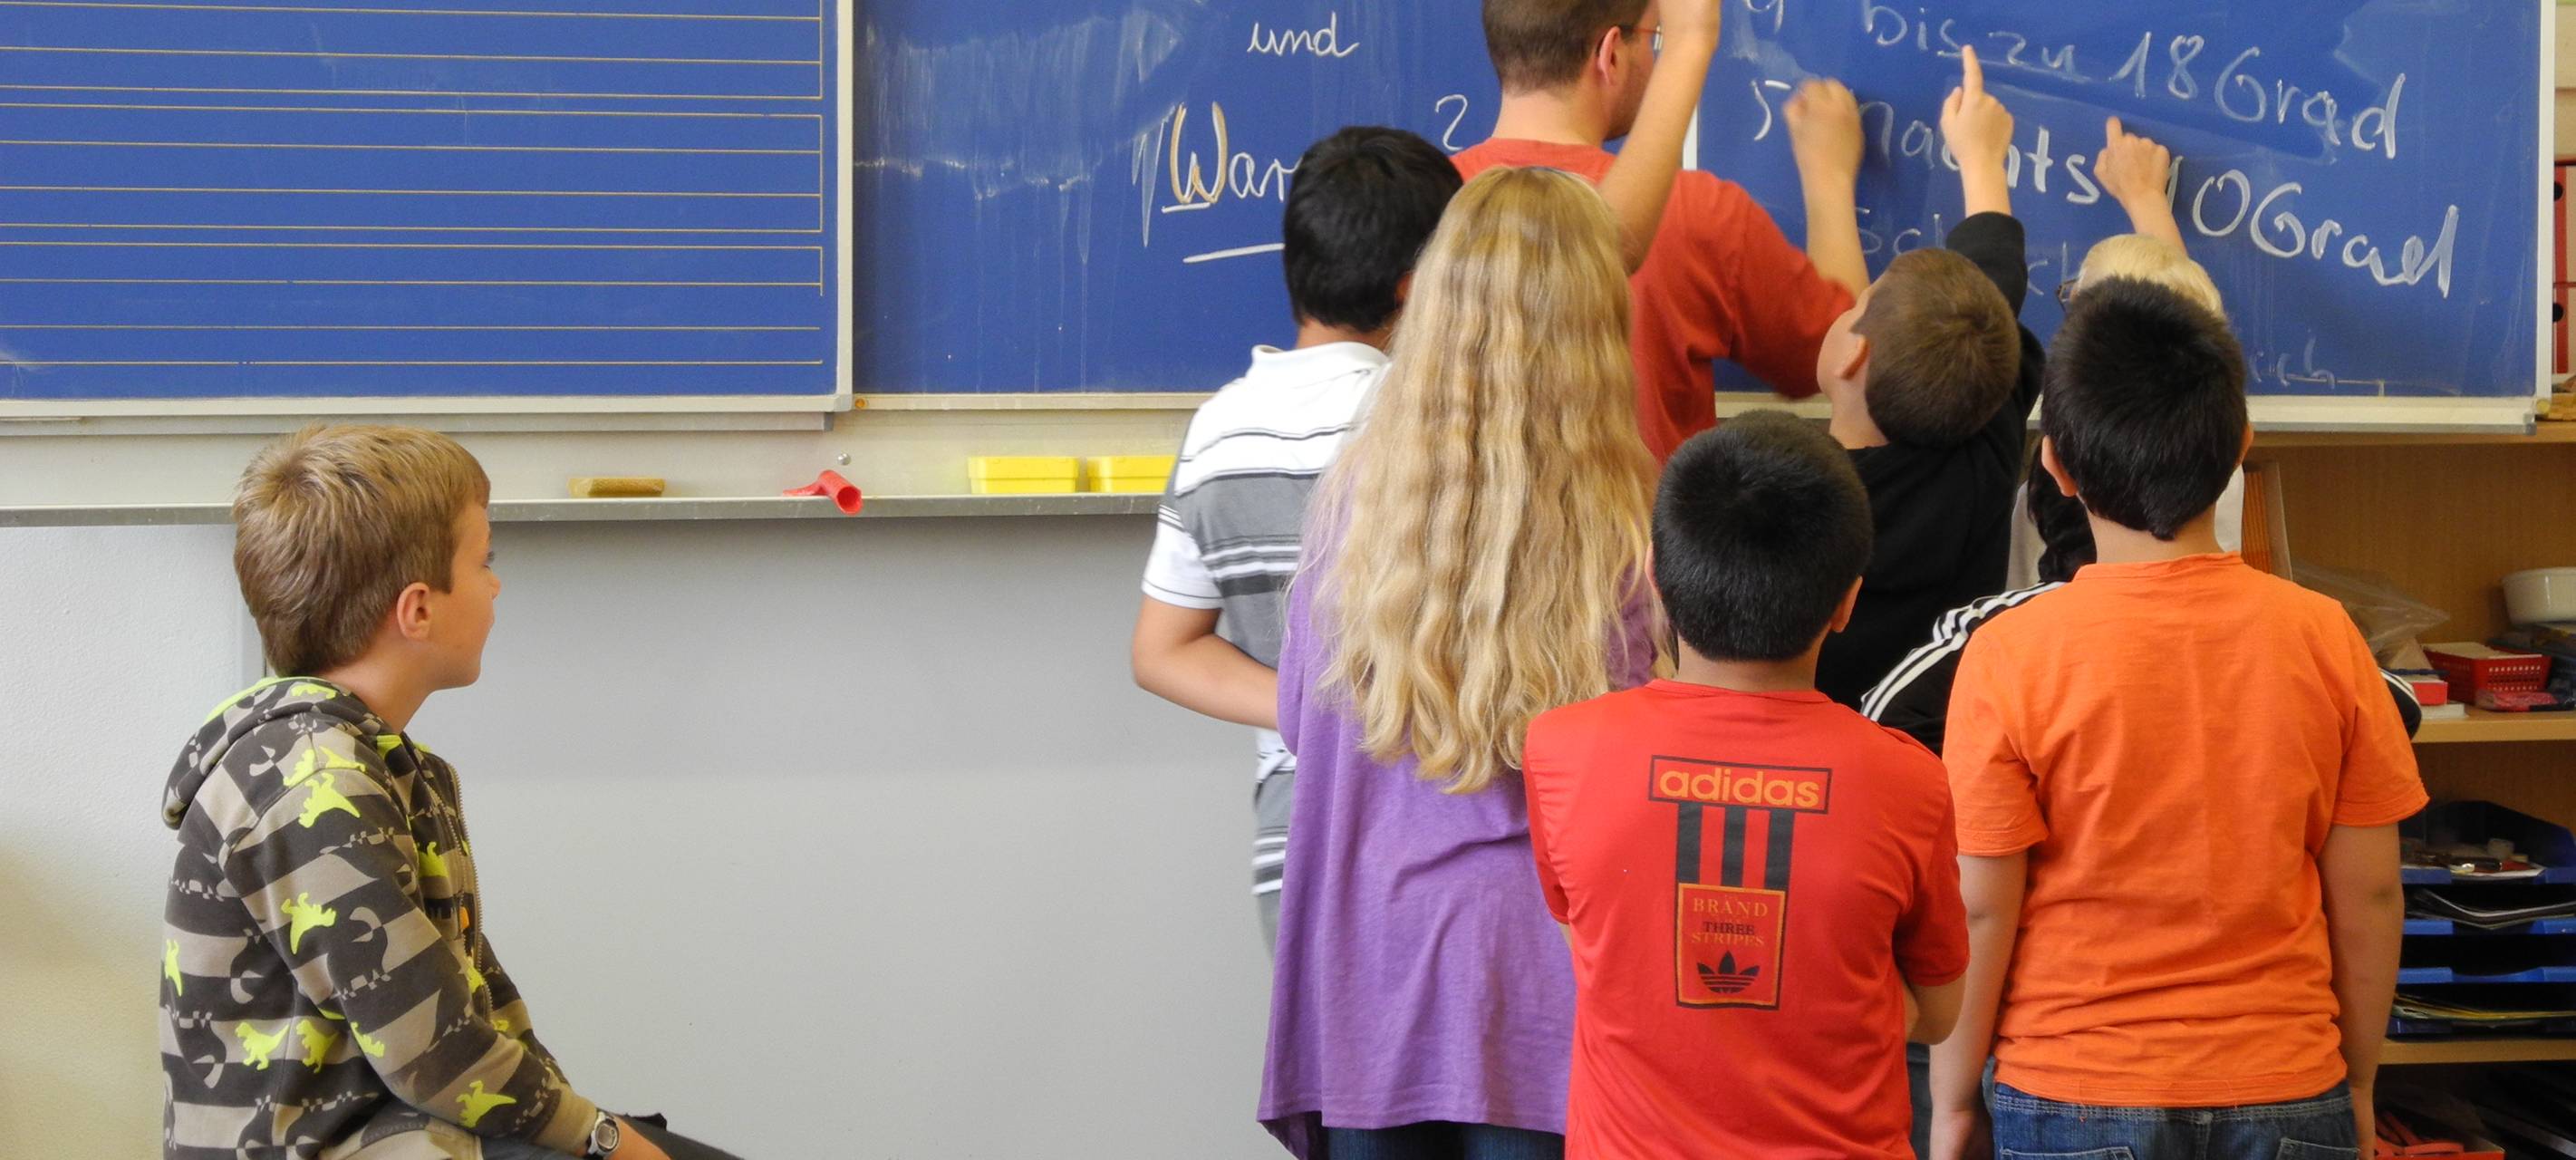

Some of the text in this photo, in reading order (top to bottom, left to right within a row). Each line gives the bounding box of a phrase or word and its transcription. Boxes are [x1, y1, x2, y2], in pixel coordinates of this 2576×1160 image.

[1247, 11, 1360, 58] und
[1659, 767, 1820, 808] adidas
[1693, 896, 1769, 918] BRAND
[1691, 931, 1766, 947] STRIPES
[1703, 920, 1755, 936] THREE
